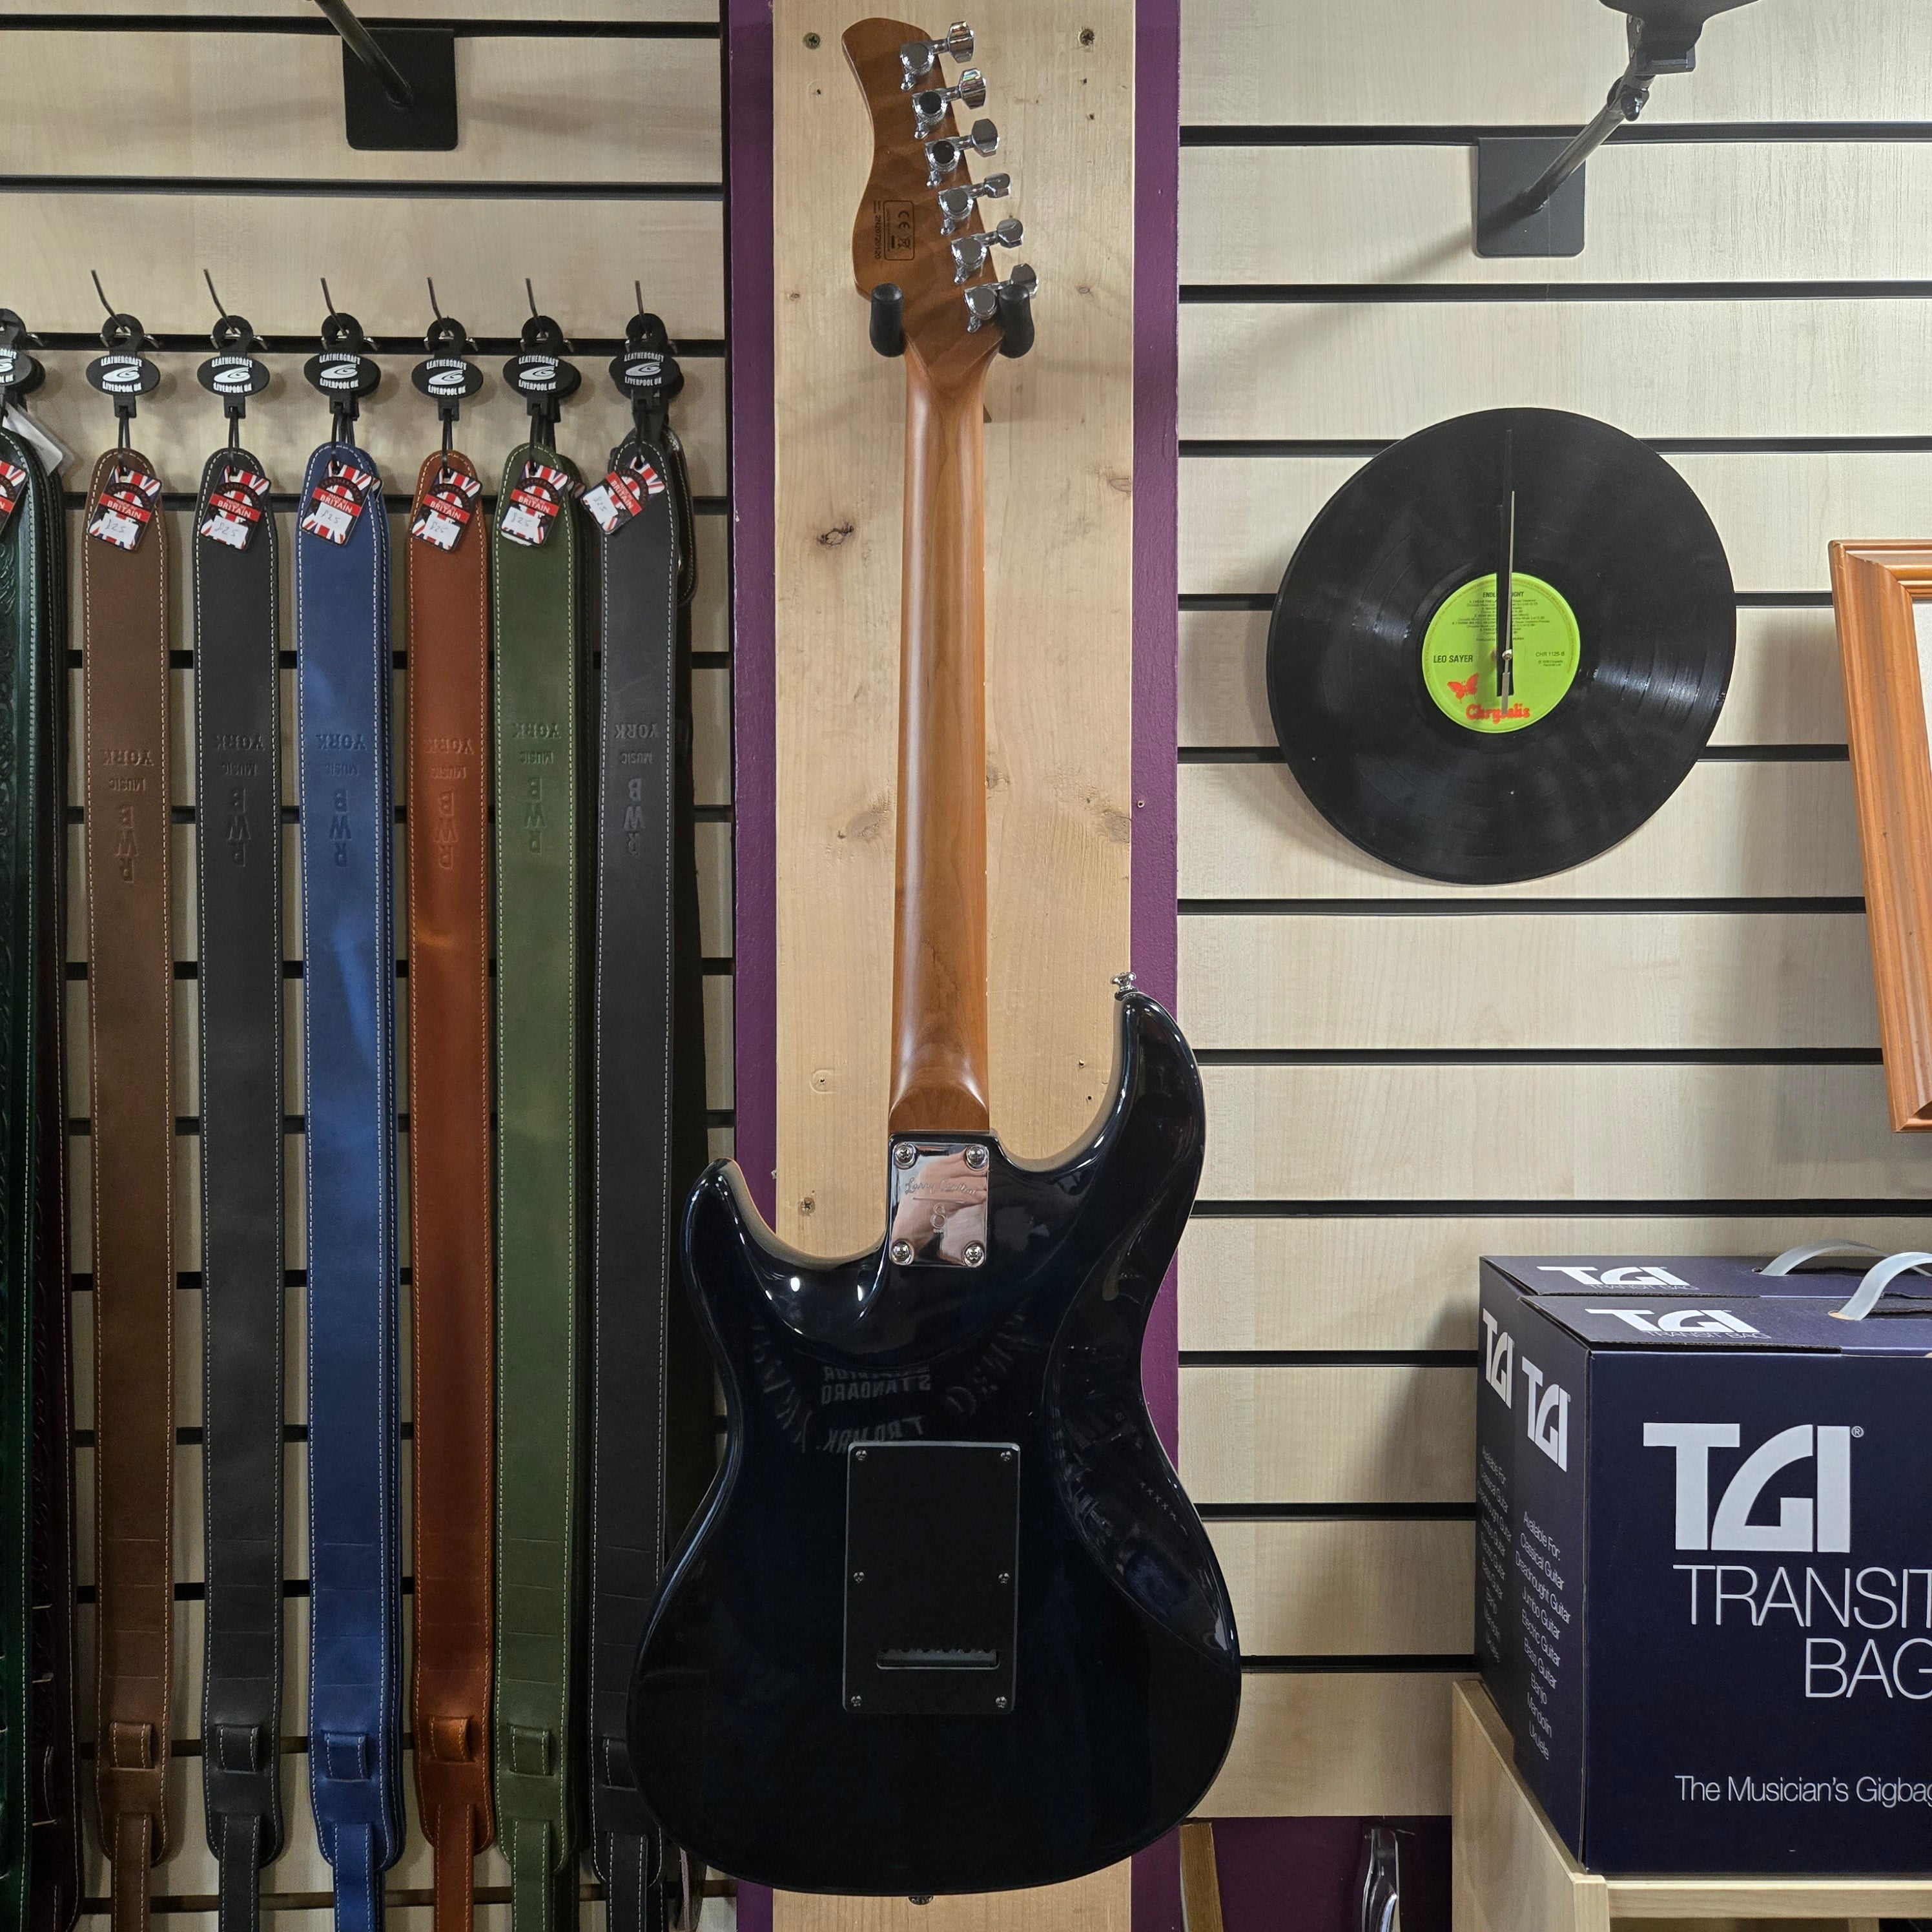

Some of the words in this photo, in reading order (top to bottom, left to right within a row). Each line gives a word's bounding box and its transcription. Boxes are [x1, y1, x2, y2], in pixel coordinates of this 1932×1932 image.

[102, 380, 133, 393] LIVERPOOL
[134, 382, 142, 391] UK
[213, 382, 243, 393] LIVERPOOL
[243, 383, 252, 392] UK
[320, 378, 350, 389] LIVERPOOL
[350, 379, 359, 388] UK
[427, 384, 457, 396] LIVERPOOL
[458, 385, 466, 395] UK
[519, 379, 548, 391] LIVERPOOL
[548, 382, 556, 390] UK
[624, 376, 653, 386] LIVERPOOL
[610, 480, 635, 509] BRITAIN
[107, 500, 141, 519] BRITAIN
[217, 499, 251, 519] BRITAIN
[320, 495, 353, 513] BRITAIN
[429, 500, 461, 520] BRITAIN
[518, 495, 551, 513] BRITAIN
[1449, 655, 1473, 663] SAYER
[513, 722, 562, 739] YORK
[614, 721, 659, 739] YORK
[215, 734, 265, 751] YORK
[316, 734, 367, 751] YORK
[424, 737, 475, 755] YORK
[102, 748, 154, 766] YORK
[904, 1177, 936, 1195] Larry
[1537, 1266, 1690, 1286] TGI
[1585, 1309, 1761, 1333] TGI
[1483, 1308, 1514, 1410] TGI
[1522, 1355, 1568, 1473] TGI
[1643, 1423, 1851, 1553] TGI
[1545, 1560, 1565, 1590] Guitar
[1550, 1593, 1571, 1624] Guitar
[1541, 1609, 1561, 1640] Guitar
[1541, 1635, 1561, 1667] Guitar
[1537, 1658, 1557, 1689] Guitar
[1531, 1672, 1548, 1705] Banjo
[1675, 1775, 1721, 1802] The
[1728, 1776, 1849, 1802] Musician's
